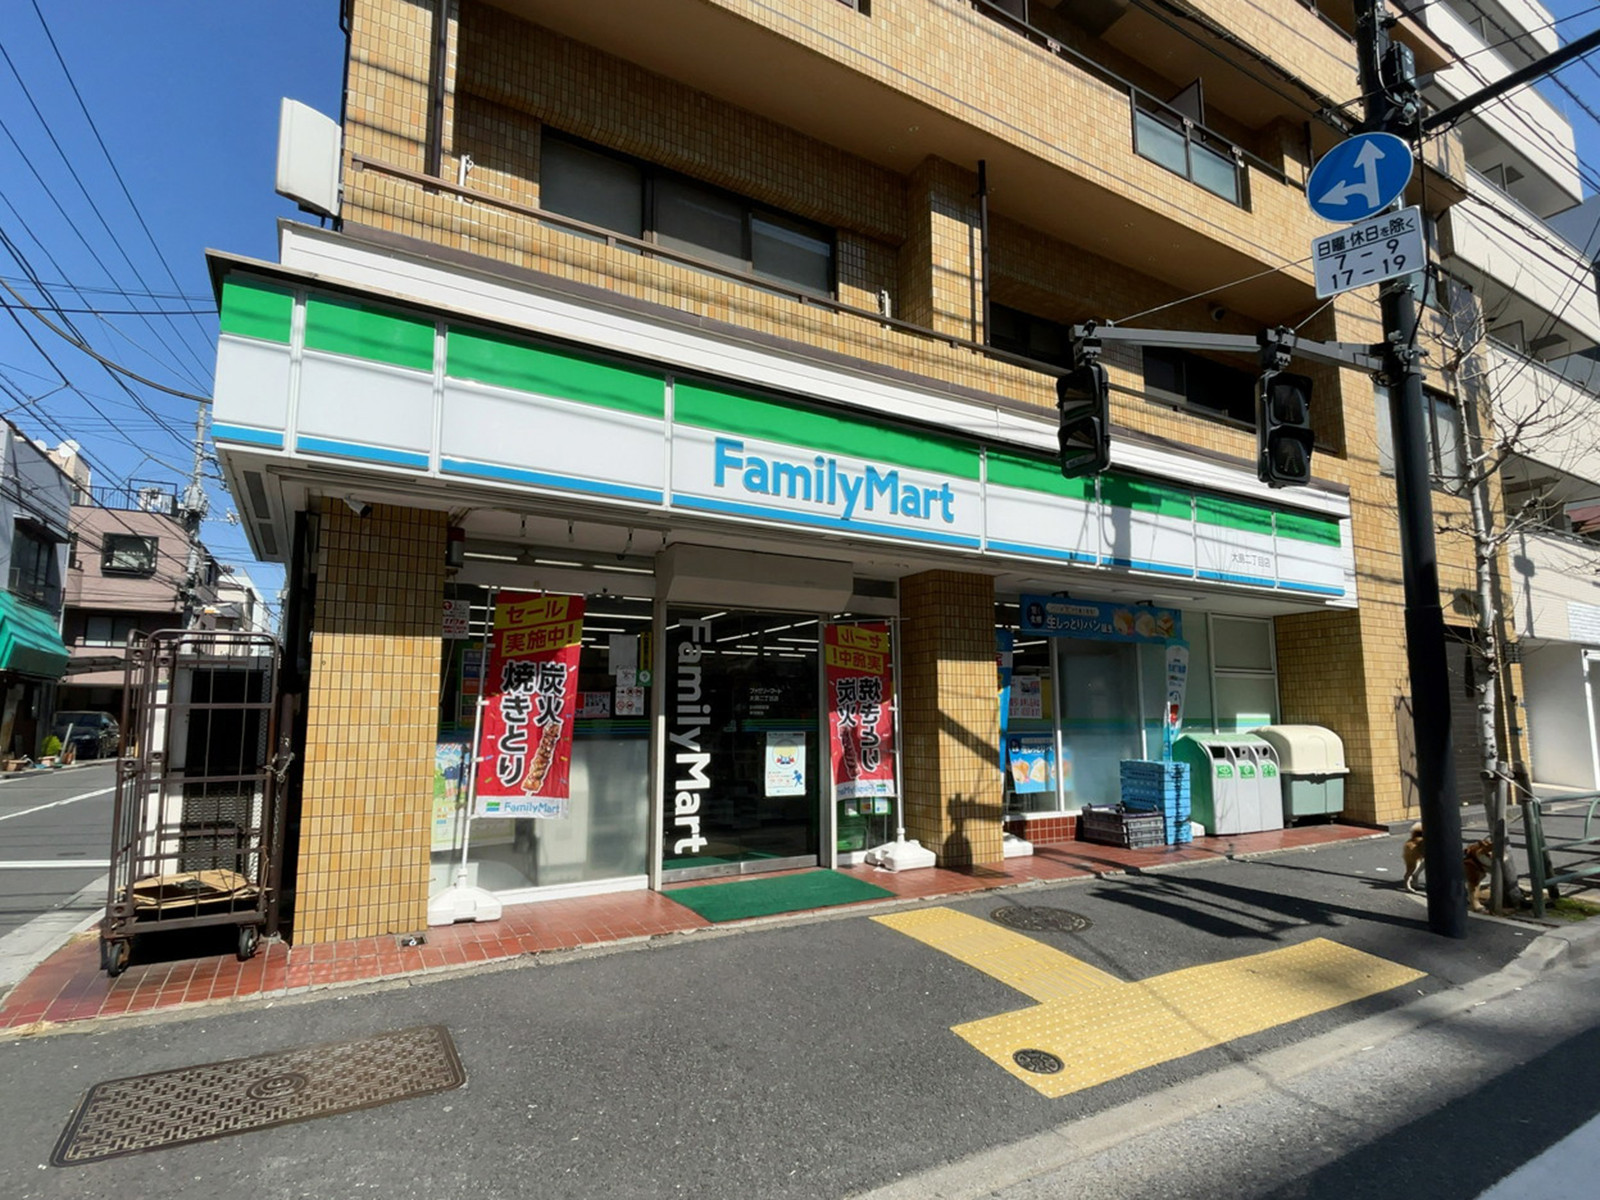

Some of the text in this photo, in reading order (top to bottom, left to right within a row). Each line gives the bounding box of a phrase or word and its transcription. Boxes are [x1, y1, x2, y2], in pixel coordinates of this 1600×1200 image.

[714, 437, 955, 523] FamilyMart
[506, 600, 564, 624] セール
[498, 660, 537, 787] 焼きとり
[534, 660, 567, 727] 炭火
[669, 618, 712, 855] FamilyMart
[504, 802, 560, 814] FamilyMart
